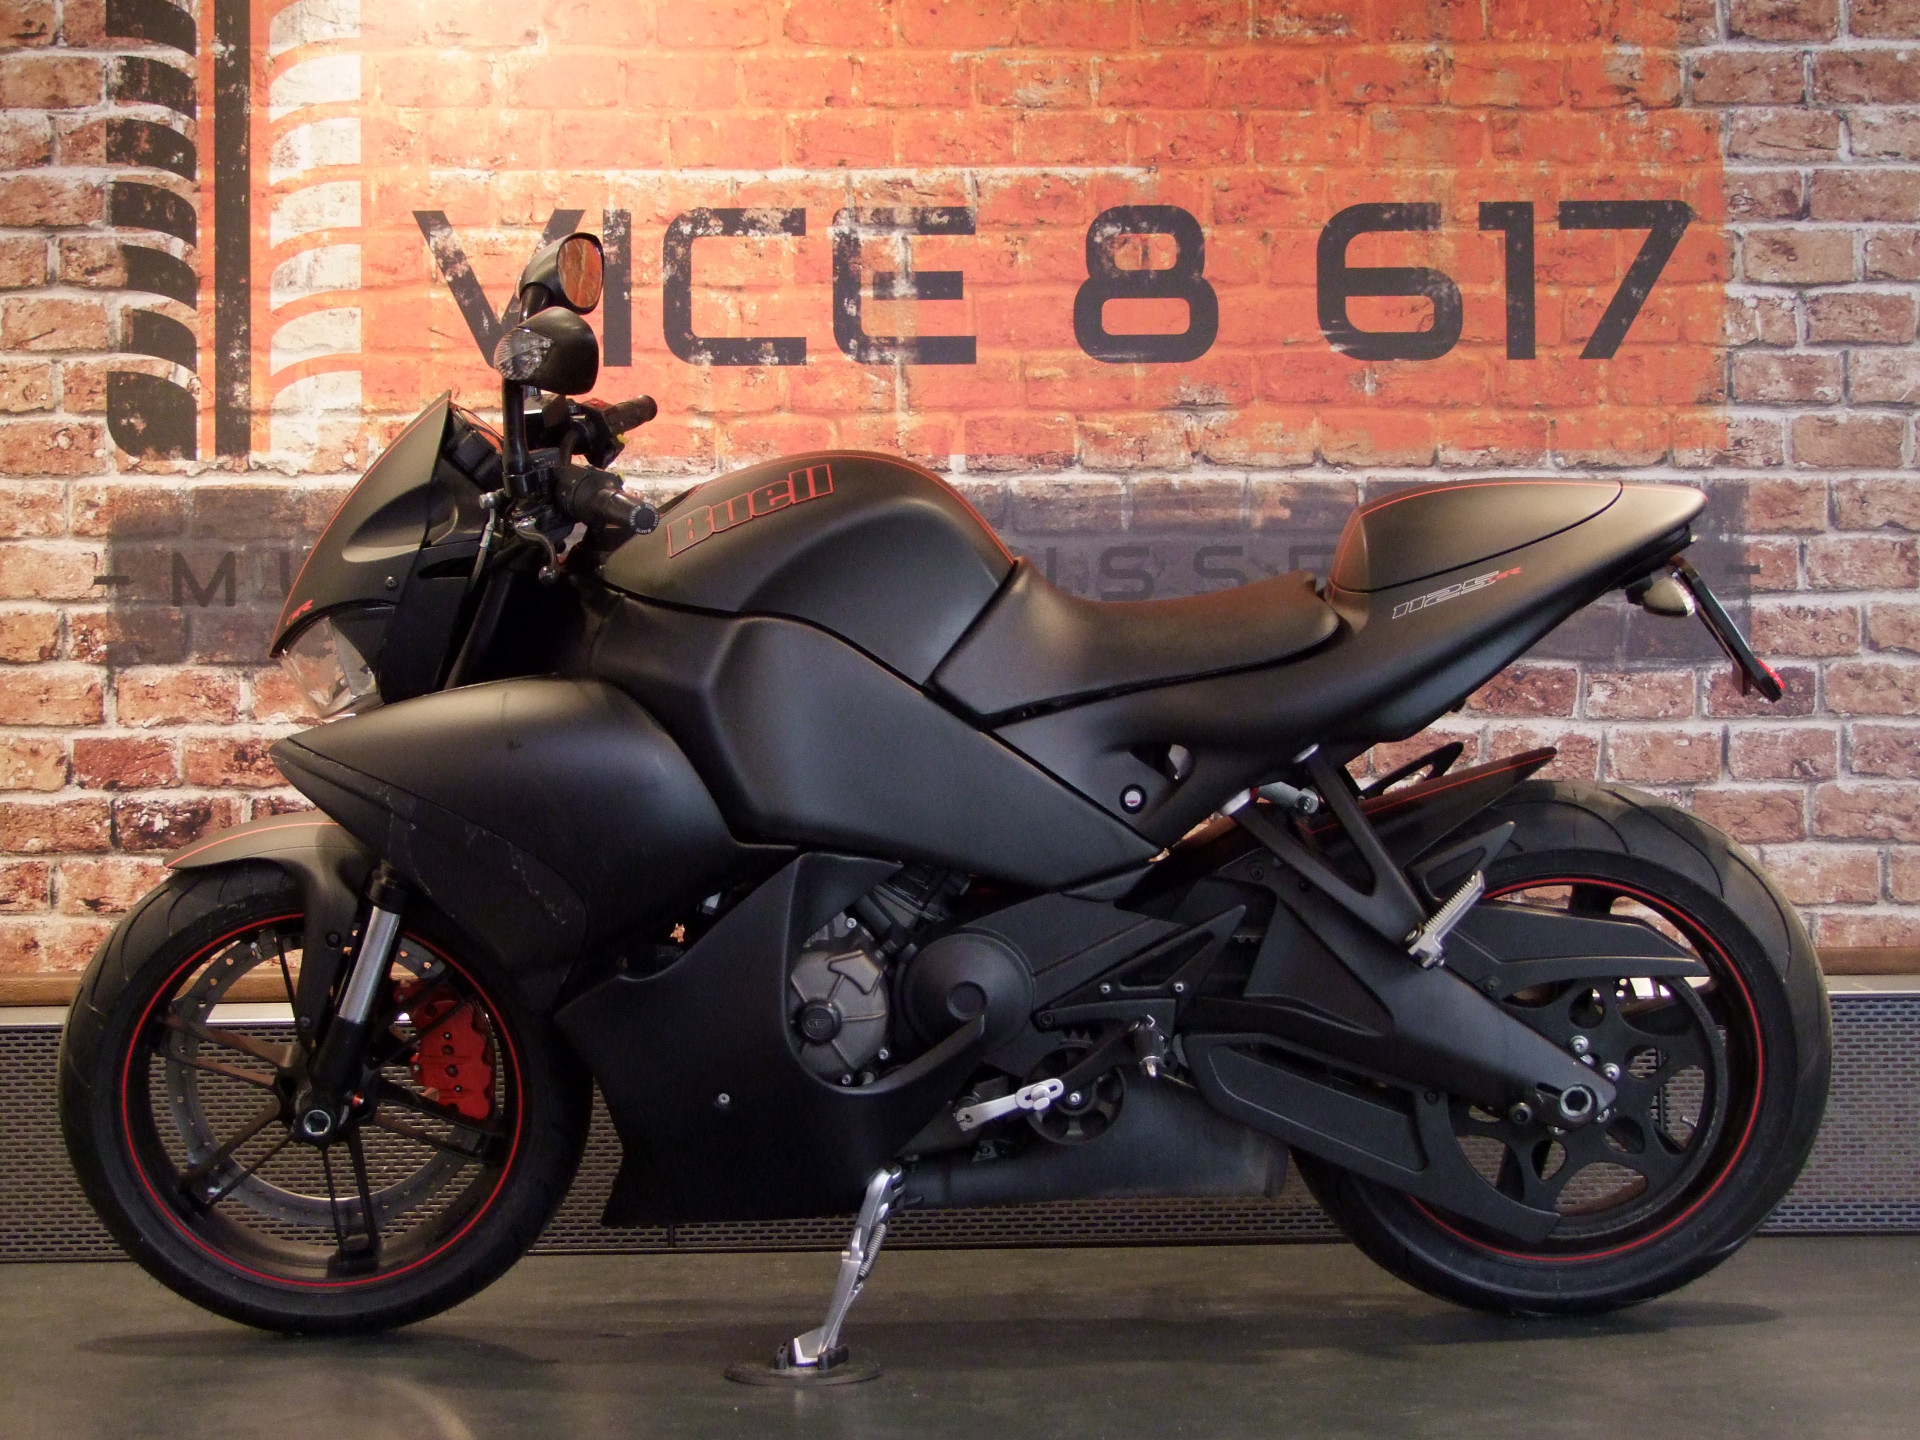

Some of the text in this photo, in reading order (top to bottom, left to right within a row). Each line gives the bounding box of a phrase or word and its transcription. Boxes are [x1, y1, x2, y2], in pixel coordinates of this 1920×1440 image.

[411, 200, 1695, 369] VICE 8 617
[666, 463, 834, 558] Buell
